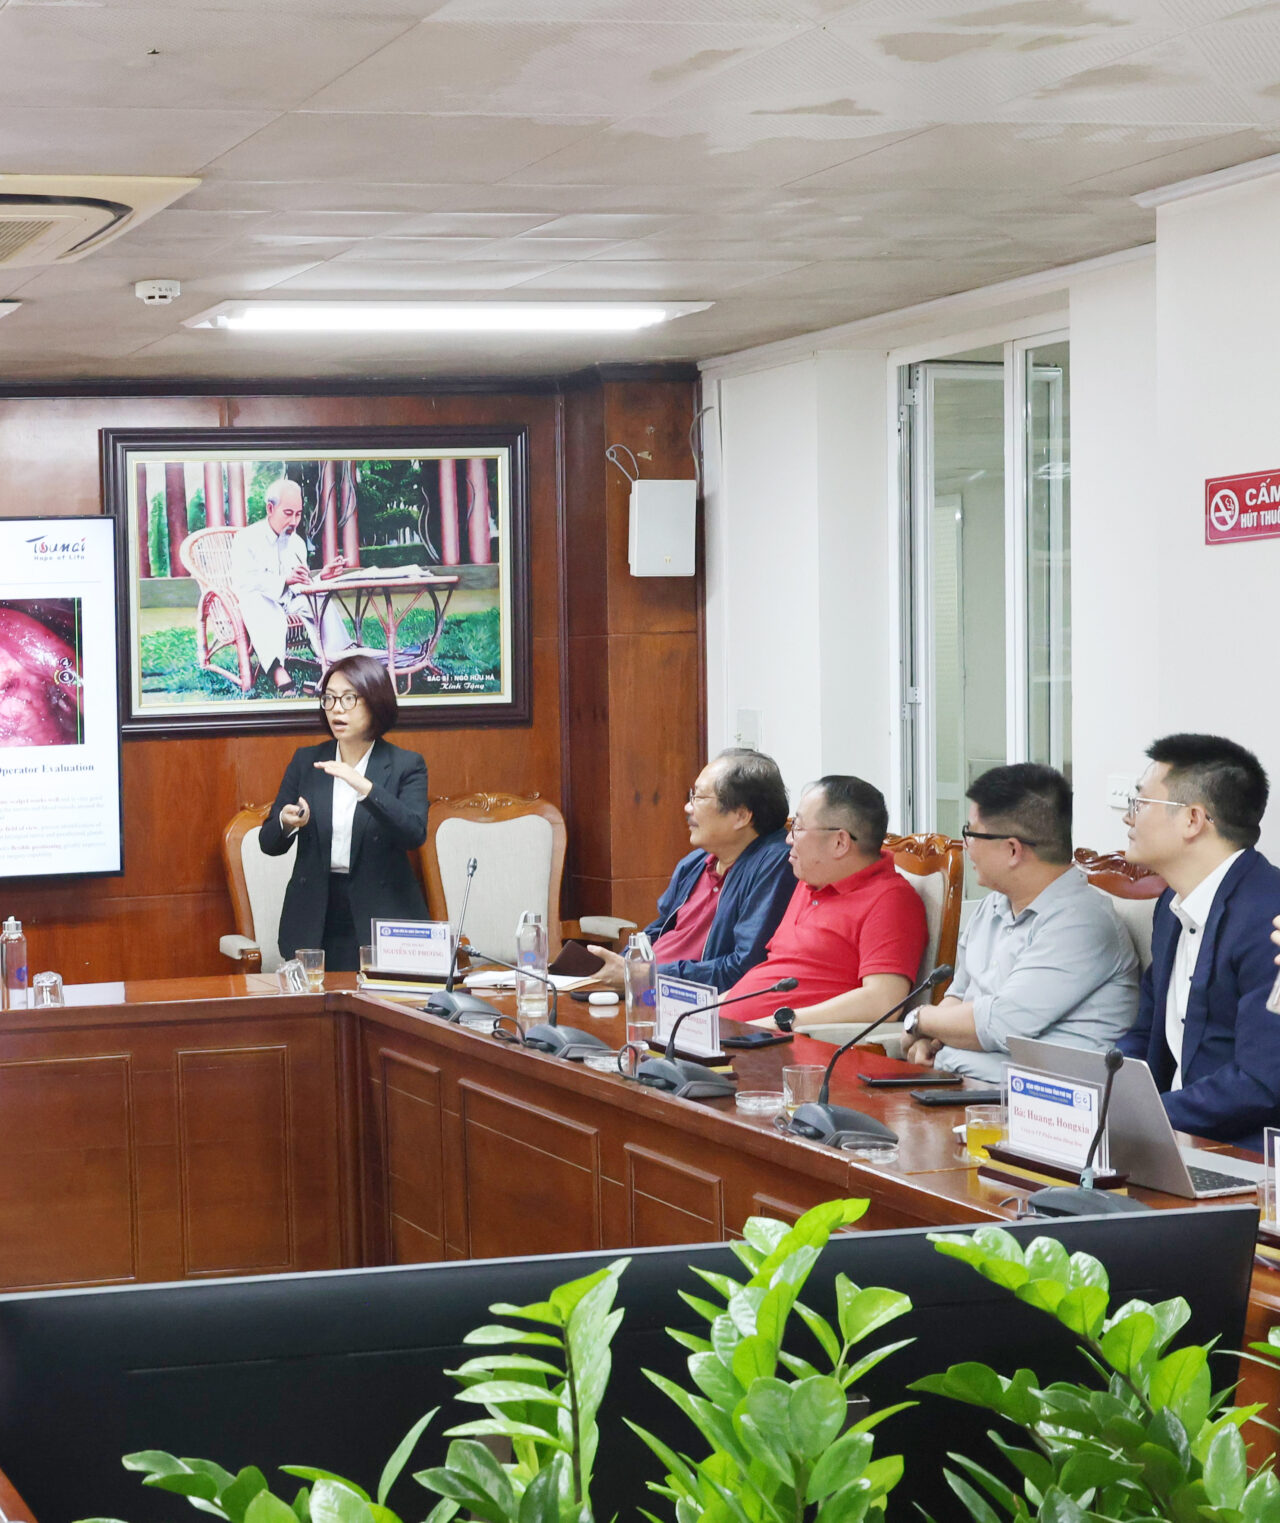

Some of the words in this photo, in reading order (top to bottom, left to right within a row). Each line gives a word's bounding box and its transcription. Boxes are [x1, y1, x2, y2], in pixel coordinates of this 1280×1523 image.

[1245, 478, 1280, 506] CẤM
[1240, 509, 1258, 528] HÚT
[42, 763, 95, 773] Evaluation
[1027, 1109, 1055, 1126] Huang,
[1056, 1117, 1090, 1134] Hongxia
